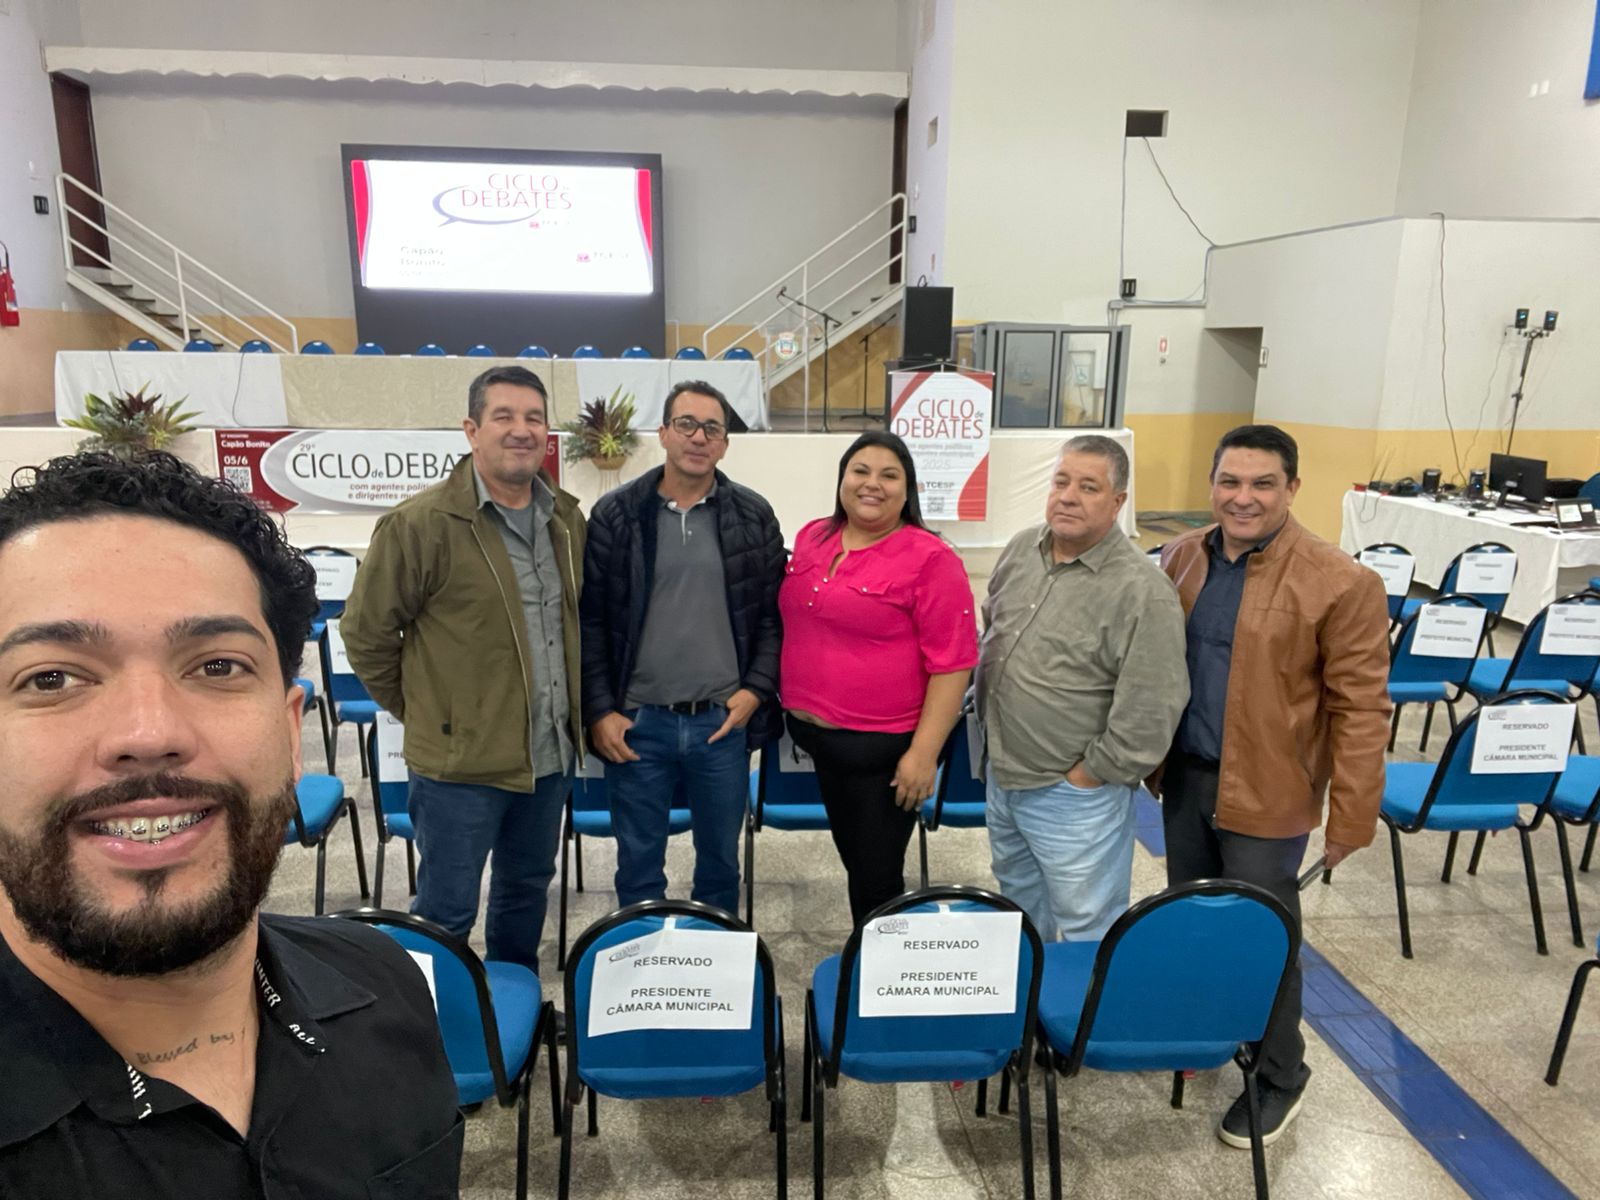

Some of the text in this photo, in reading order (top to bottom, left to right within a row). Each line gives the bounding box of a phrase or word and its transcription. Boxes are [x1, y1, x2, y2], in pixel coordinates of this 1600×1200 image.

[488, 172, 559, 192] CICLO
[462, 189, 572, 210] DEBATES
[917, 398, 974, 419] CICLO
[896, 418, 983, 439] DEBATES
[221, 440, 271, 448] Capão Bonito
[223, 455, 248, 465] 05/6
[292, 452, 371, 479] CICLO
[371, 469, 384, 479] de
[371, 484, 405, 493] agentes
[355, 492, 398, 501] dirigentes
[1518, 753, 1559, 761] MUNICIPAL
[903, 940, 980, 950] RESERVADO
[633, 956, 713, 968] RESERVADO
[900, 972, 978, 982] PRESIDENTE
[631, 987, 712, 998] PRESIDENTE
[877, 985, 1000, 996] CÂMARA MUNICIPAL
[606, 1001, 734, 1016] CÂMARA MUNICIPAL
